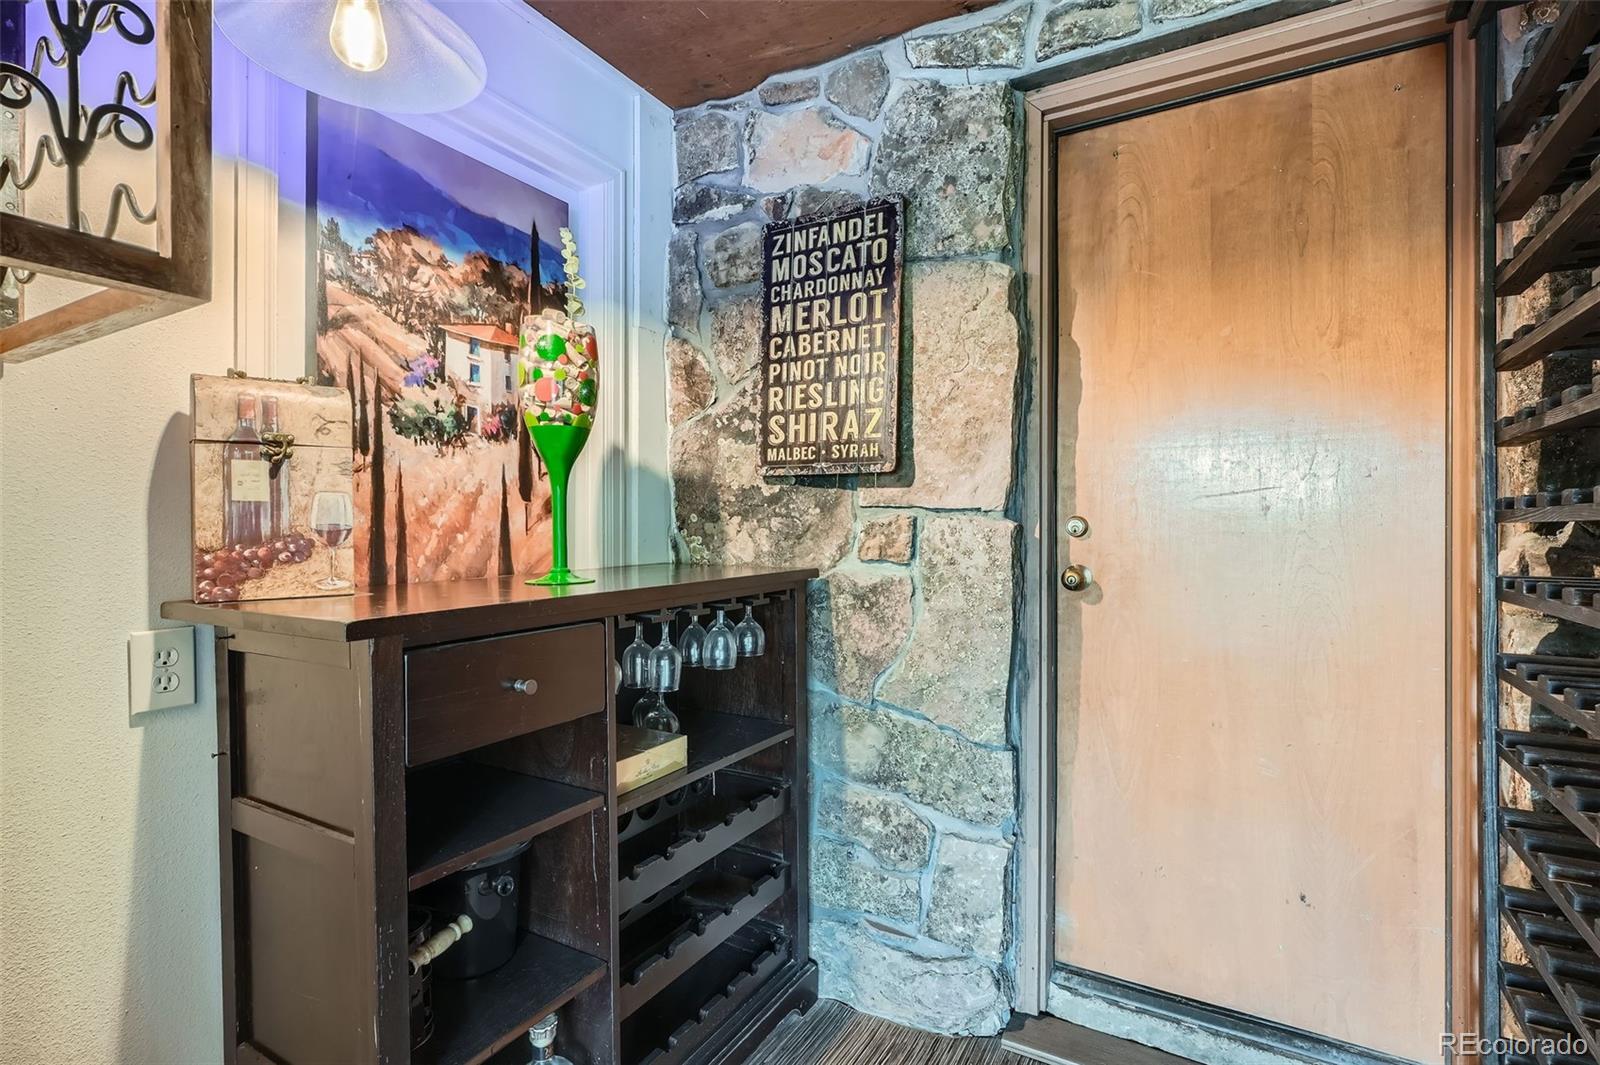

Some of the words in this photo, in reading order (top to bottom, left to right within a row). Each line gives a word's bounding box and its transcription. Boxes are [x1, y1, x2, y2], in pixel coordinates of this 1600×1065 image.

[771, 212, 888, 257] ZINFANDEL
[771, 238, 888, 284] MOSCATO
[770, 267, 886, 302] CHARDONNAY
[769, 288, 887, 335] MERLOT
[769, 323, 886, 361] CABERNET
[769, 358, 828, 384] PINOT
[834, 350, 886, 380] NOIR
[768, 377, 885, 412] RIESLING
[767, 407, 883, 446] SHIRAZ
[767, 446, 816, 461] MALBEC
[831, 442, 879, 458] SYRAH
